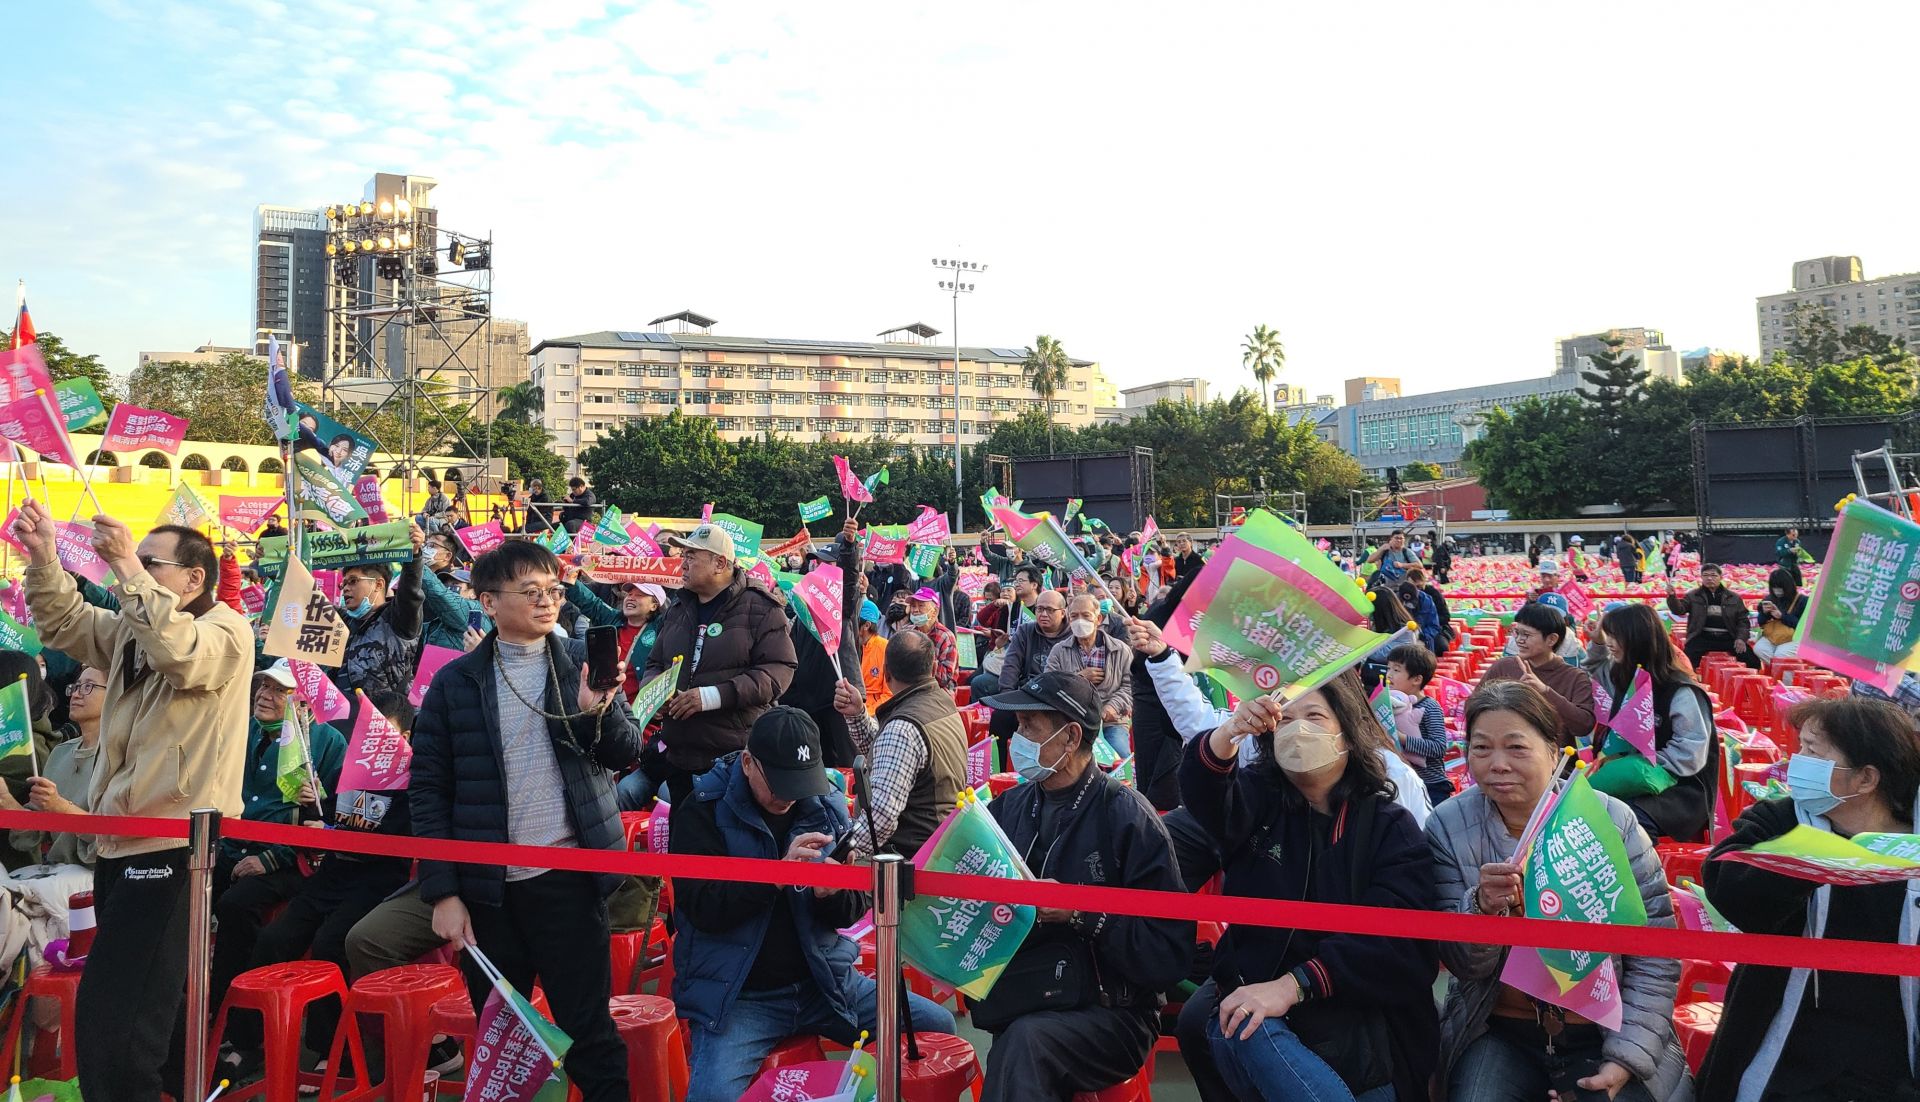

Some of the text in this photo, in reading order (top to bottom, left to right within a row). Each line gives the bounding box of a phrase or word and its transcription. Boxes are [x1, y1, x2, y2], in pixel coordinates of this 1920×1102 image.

[1546, 832, 1612, 925] 走對的路
[1561, 817, 1625, 913] 選對的人
